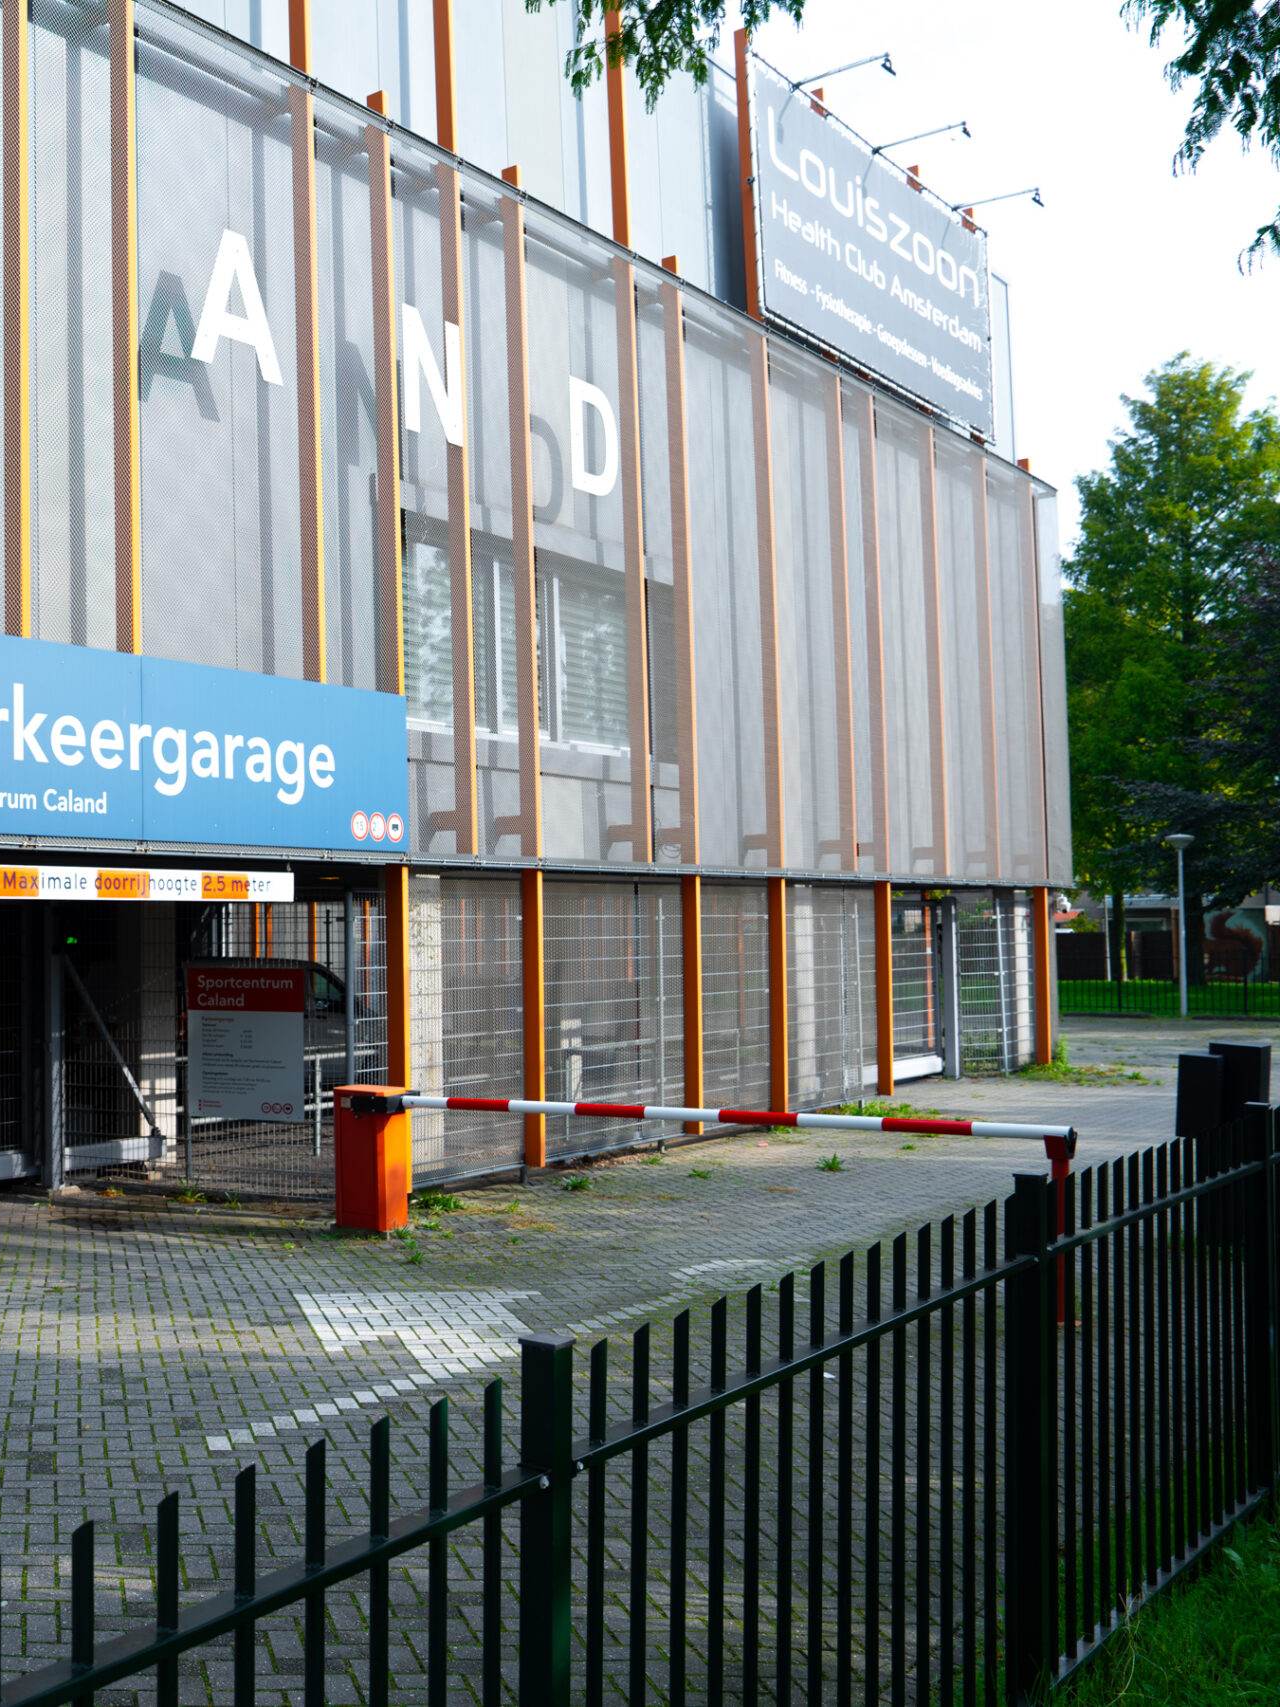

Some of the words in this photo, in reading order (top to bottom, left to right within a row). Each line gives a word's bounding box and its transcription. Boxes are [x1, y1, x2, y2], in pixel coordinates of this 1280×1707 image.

[767, 105, 980, 308] Louiszoon
[771, 191, 841, 261] Health
[845, 243, 887, 290] Club
[890, 274, 983, 353] Amsterdam
[774, 257, 808, 295] Fitness
[43, 789, 108, 814] Caland
[2, 871, 87, 890] Maximale
[94, 872, 197, 898] doorrijhoogte
[231, 877, 272, 892] meter
[197, 975, 294, 991] Sportcentrum
[197, 993, 245, 1007] Caland
